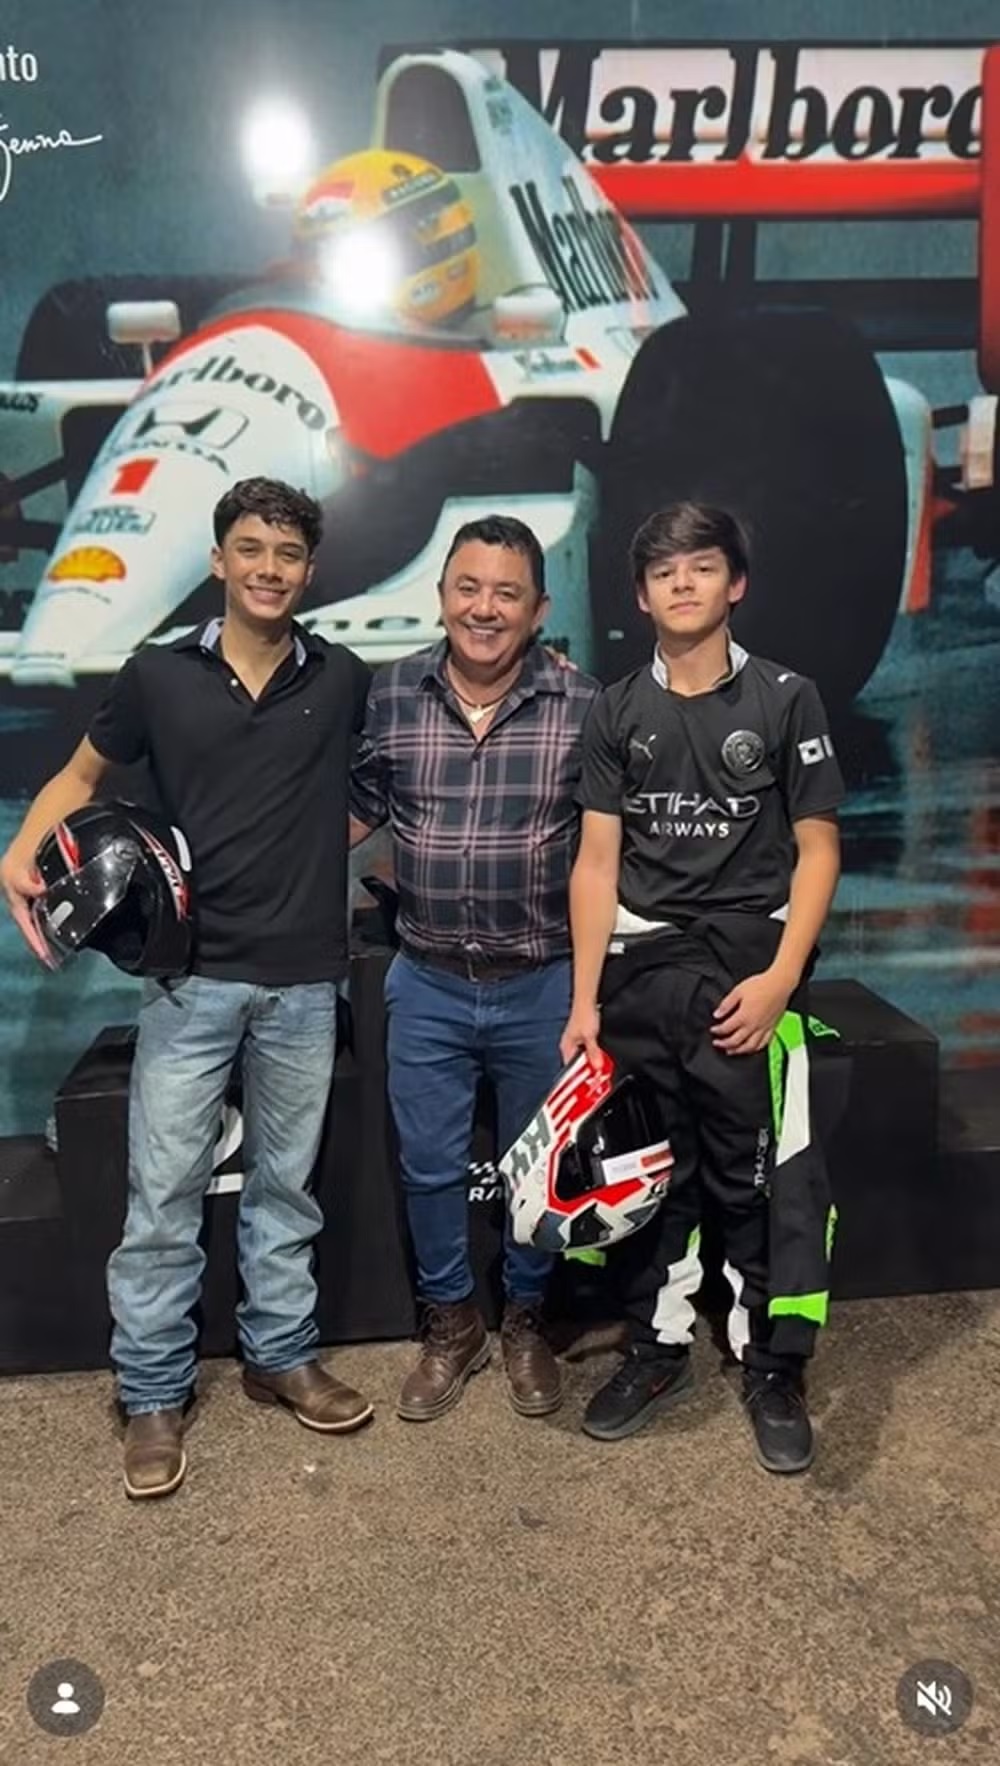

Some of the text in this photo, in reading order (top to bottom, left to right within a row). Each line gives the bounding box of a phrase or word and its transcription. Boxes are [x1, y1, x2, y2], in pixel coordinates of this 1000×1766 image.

[143, 356, 326, 430] arlboro
[112, 459, 159, 494] 1
[625, 792, 761, 818] ETIHAD
